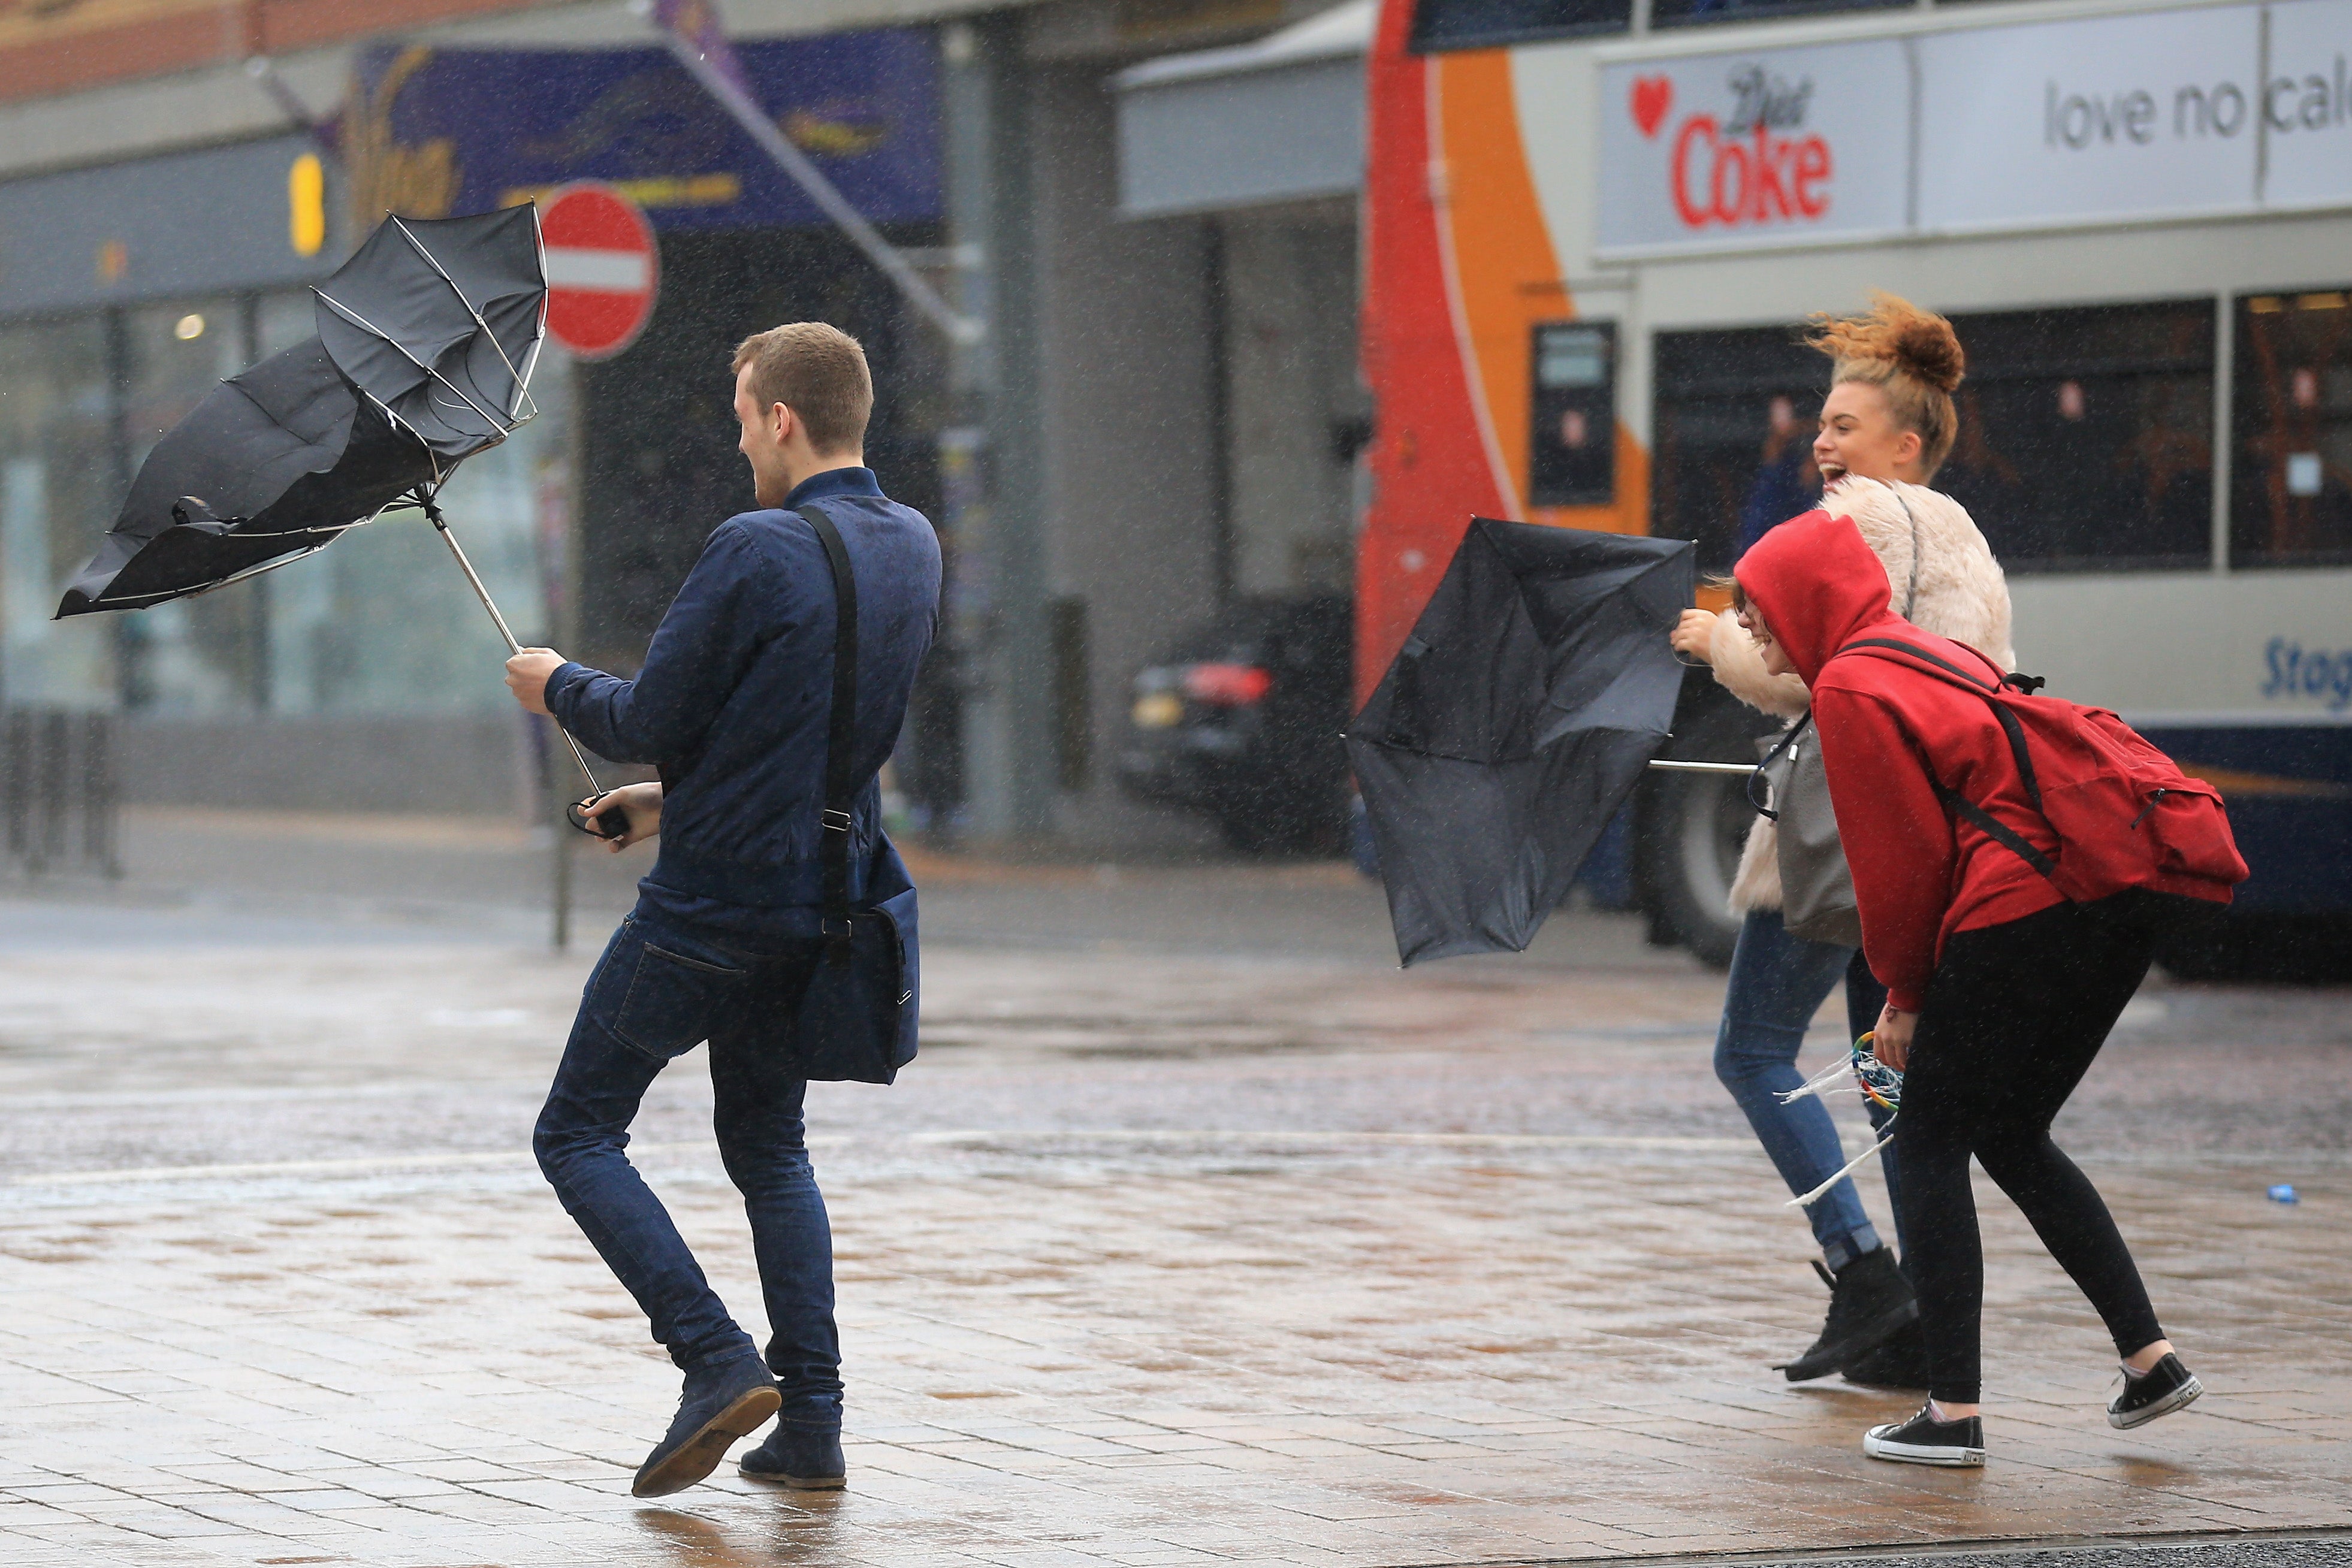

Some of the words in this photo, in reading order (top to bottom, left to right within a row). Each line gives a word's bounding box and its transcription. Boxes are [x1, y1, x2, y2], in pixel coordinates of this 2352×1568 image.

[2045, 80, 2156, 149] love
[2173, 83, 2246, 139] no
[2264, 52, 2352, 134] cal
[1671, 114, 1831, 230] Coke
